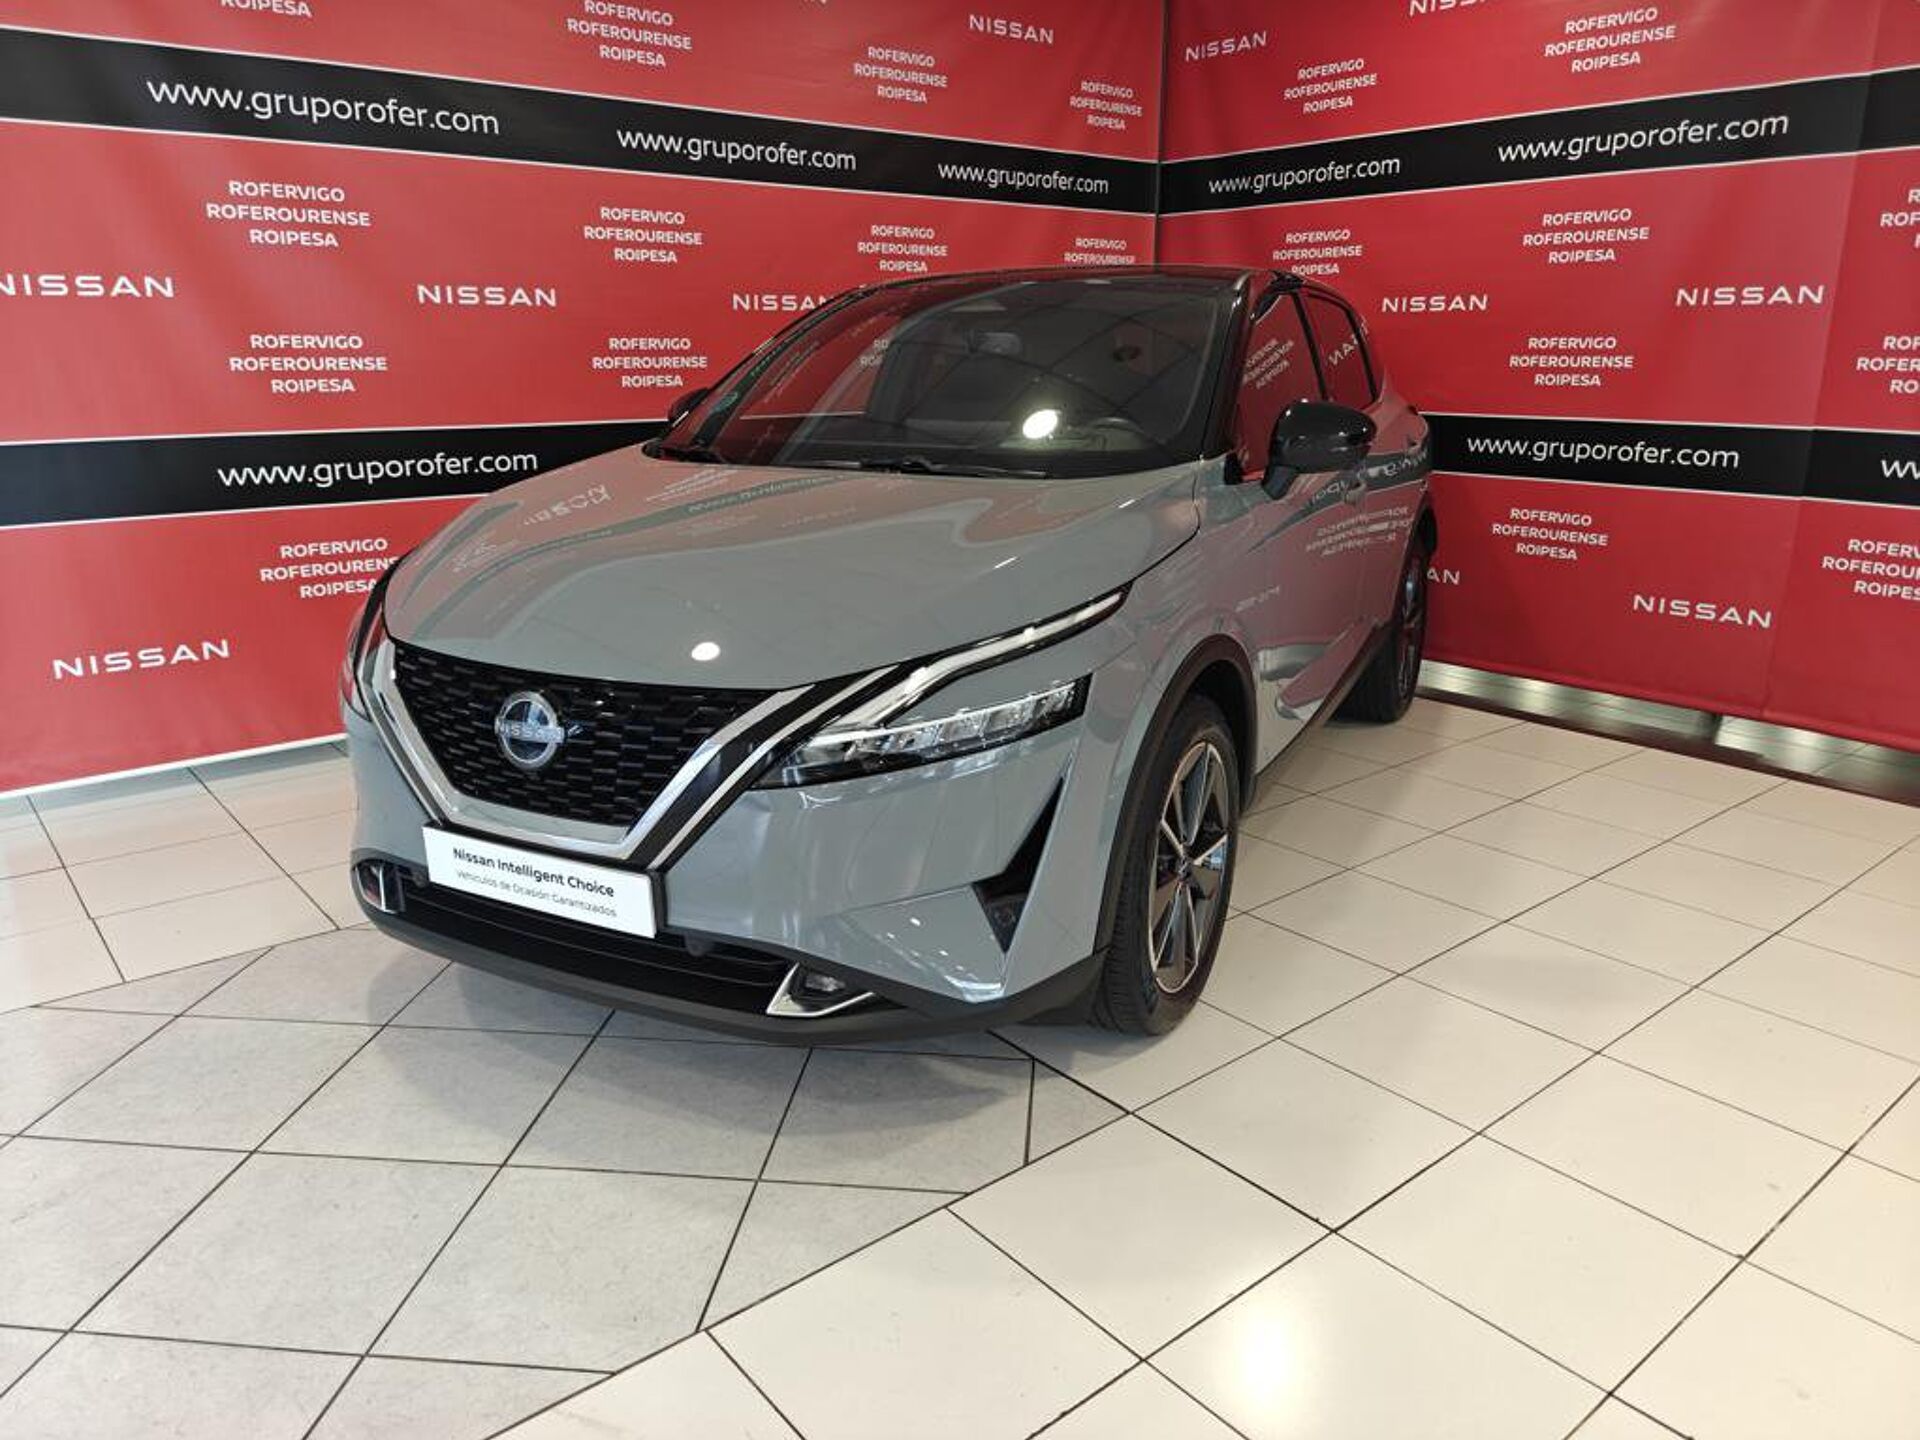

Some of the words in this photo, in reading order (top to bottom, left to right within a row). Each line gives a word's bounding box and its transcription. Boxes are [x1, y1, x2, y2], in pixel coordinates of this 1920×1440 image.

[585, 0, 673, 27] ROFERVIGO
[1565, 7, 1657, 34] ROFERVIGO
[567, 18, 693, 50] ROFEROURENSE
[970, 15, 1053, 44] NISSAN
[1186, 30, 1267, 62] NISSAN
[1544, 25, 1677, 58] ROFEROURENSE
[600, 45, 666, 68] ROIPESA
[869, 47, 936, 68] ROFERVIGO
[1572, 51, 1641, 73] ROIPESA
[854, 62, 948, 88] ROFEROURENSE
[1298, 58, 1365, 80] ROFERVIGO
[877, 84, 928, 104] ROIPESA
[1081, 80, 1134, 99] ROFERVIGO
[1284, 73, 1378, 101] ROFEROURENSE
[146, 80, 500, 135] www.gruporofer.com
[1070, 95, 1143, 117] ROFEROURENSE
[1303, 96, 1354, 114] ROIPESA
[1087, 114, 1126, 130] ROIPESA
[1498, 115, 1790, 163] www.gruporofer.com
[616, 129, 857, 171] www.gruporofer.com
[938, 163, 1109, 194] www.gruporofer.com
[1208, 157, 1401, 194] www.gruporofer.com
[229, 180, 345, 203] ROFERVIGO
[206, 203, 371, 227] ROFEROURENSE
[600, 206, 686, 225] ROFERVIGO
[1543, 207, 1633, 227] ROFERVIGO
[250, 228, 339, 248] ROIPESA
[584, 226, 703, 245] ROFEROURENSE
[870, 224, 936, 240] ROFERVIGO
[1286, 229, 1351, 244] ROFERVIGO
[1523, 227, 1650, 246] ROFEROURENSE
[857, 241, 948, 257] ROFEROURENSE
[1075, 237, 1127, 251] ROFERVIGO
[1272, 244, 1363, 261] ROFEROURENSE
[614, 248, 678, 264] ROIPESA
[880, 259, 928, 273] ROIPESA
[1548, 248, 1617, 264] ROIPESA
[0, 273, 175, 298] NISSAN
[417, 284, 557, 307] NISSAN
[1676, 285, 1825, 307] NISSAN
[1381, 293, 1488, 313] NISSAN
[250, 334, 364, 350] ROFERVIGO
[608, 337, 692, 351] ROFERVIGO
[1528, 336, 1618, 350] ROFERVIGO
[229, 356, 388, 372] ROFEROURENSE
[591, 355, 708, 370] ROFEROURENSE
[1509, 354, 1634, 369] ROFEROURENSE
[271, 378, 356, 394] ROIPESA
[622, 374, 684, 388] ROIPESA
[1534, 374, 1602, 387] ROIPESA
[1466, 437, 1740, 469] www.gruporofer.com
[217, 451, 539, 489] www.gruporofer.com
[1510, 508, 1593, 526] ROFERVIGO
[1491, 522, 1609, 547] ROFEROURENSE
[280, 537, 389, 559] ROFERVIGO
[1515, 542, 1578, 561] ROIPESA
[1821, 556, 1920, 580] ROFEROU
[1633, 594, 1772, 629] NISSAN
[53, 638, 230, 680] NISSAN
[453, 848, 495, 867] Nissan
[497, 860, 565, 885] Intelligent
[567, 875, 615, 898] Choice
